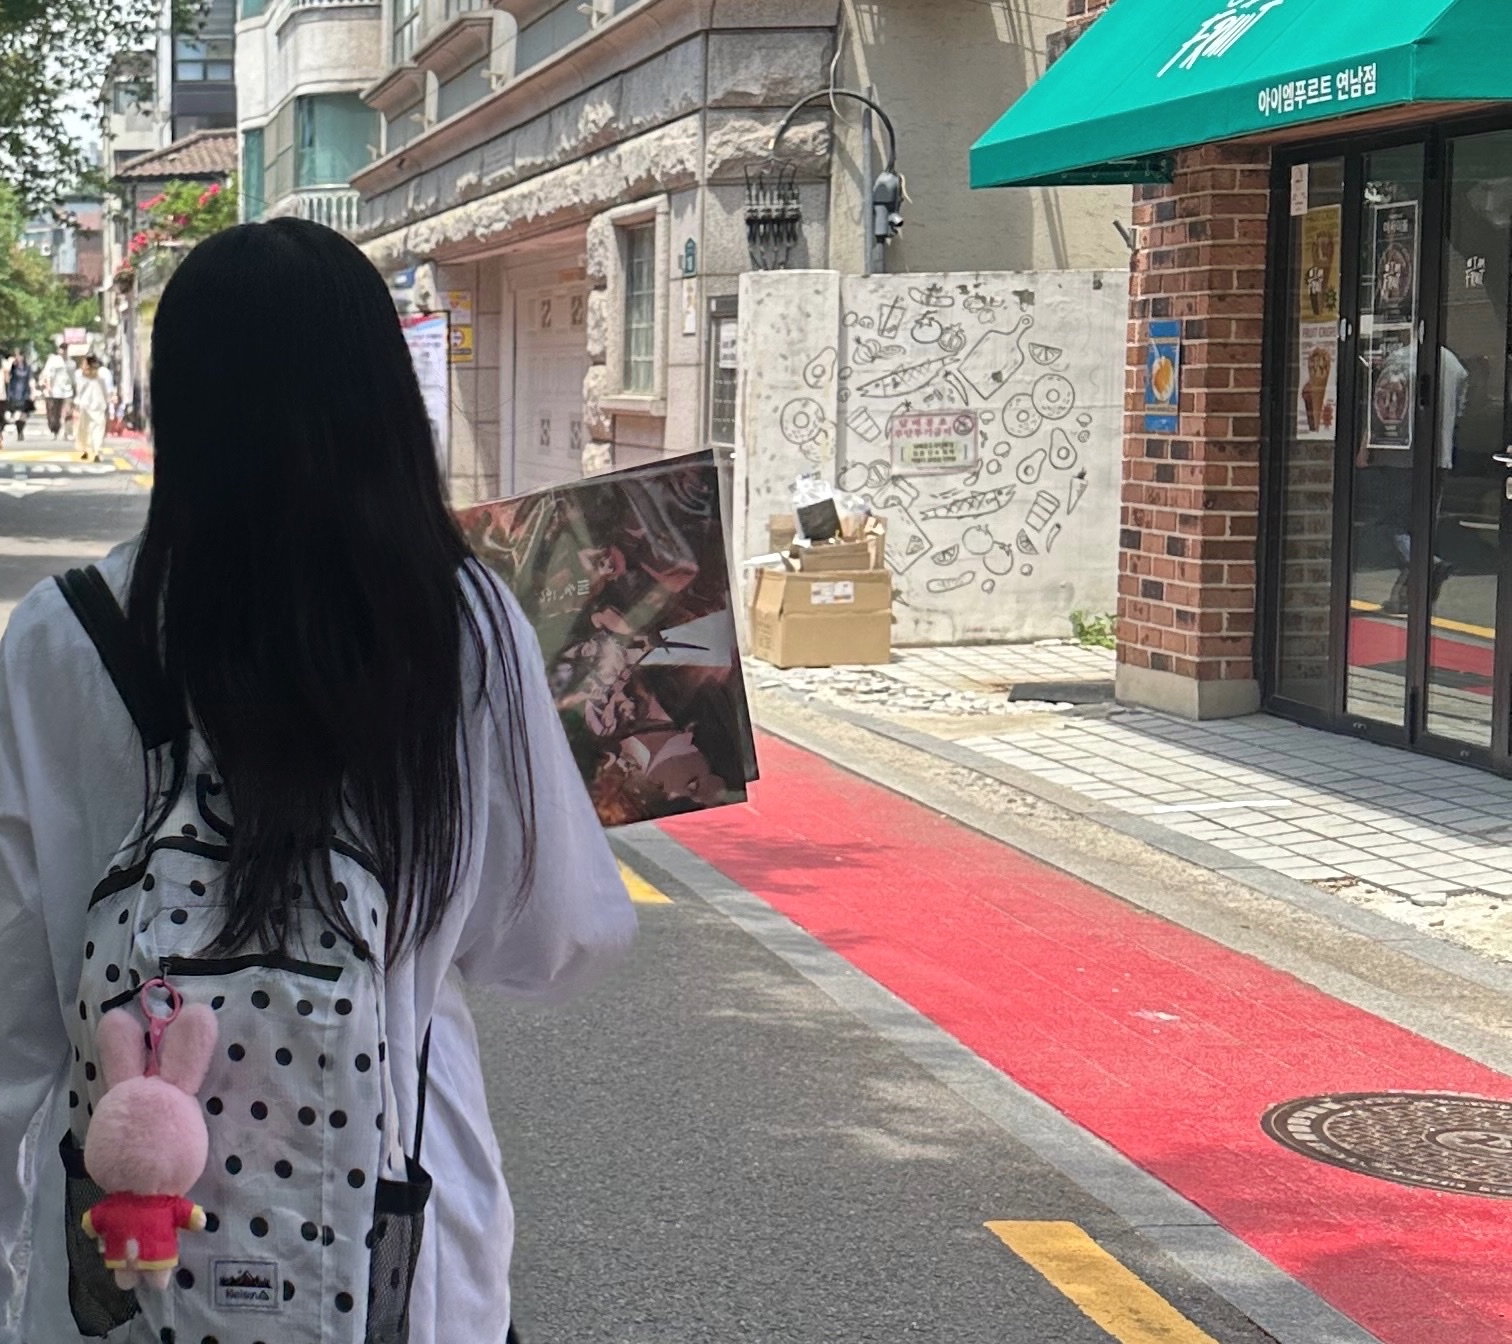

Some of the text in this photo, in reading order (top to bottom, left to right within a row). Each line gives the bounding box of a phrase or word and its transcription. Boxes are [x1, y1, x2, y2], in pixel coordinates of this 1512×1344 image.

[1156, 0, 1285, 78] FRUIT
[1257, 62, 1377, 117] 아이엠푸르트 연남점
